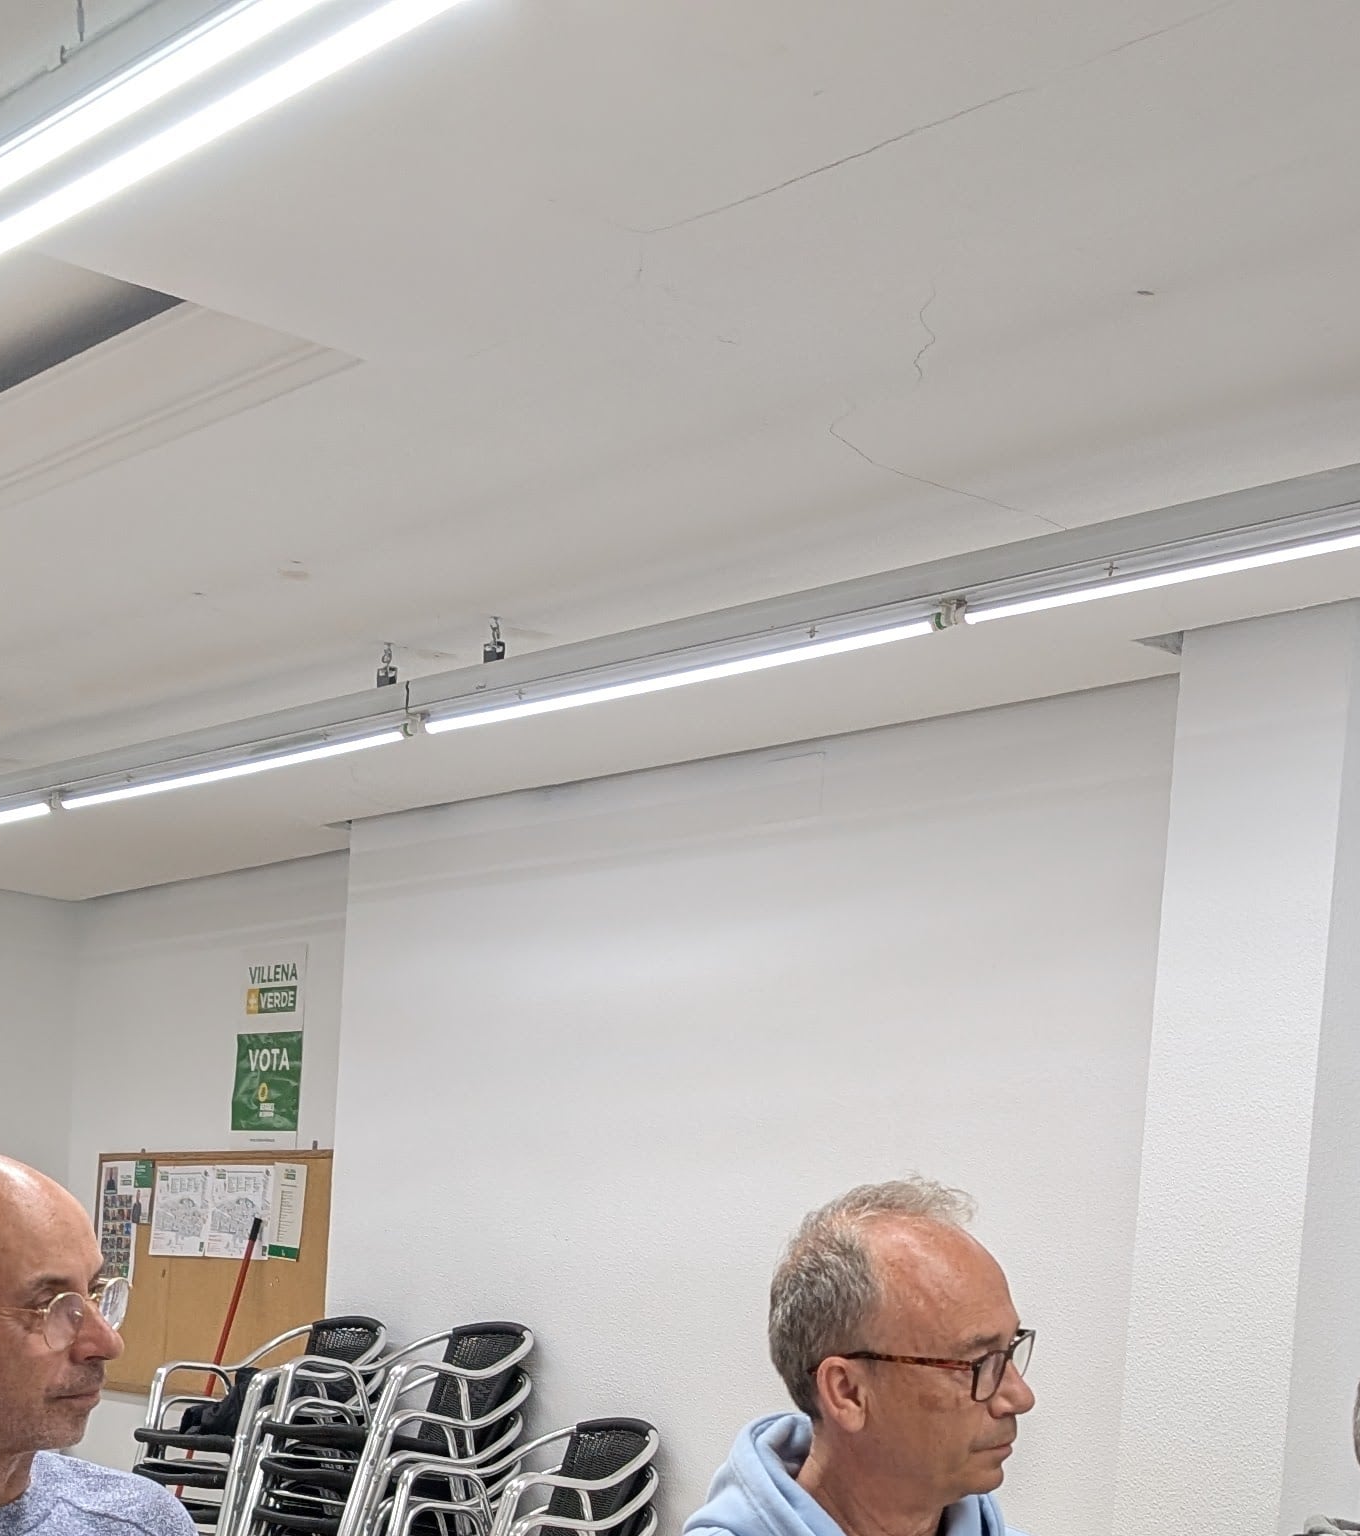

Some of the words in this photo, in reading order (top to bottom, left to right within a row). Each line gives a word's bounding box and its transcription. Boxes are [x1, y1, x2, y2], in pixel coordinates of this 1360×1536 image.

[249, 963, 298, 985] VILLENA
[259, 990, 295, 1009] VERDE
[248, 1048, 290, 1072] VOTA
